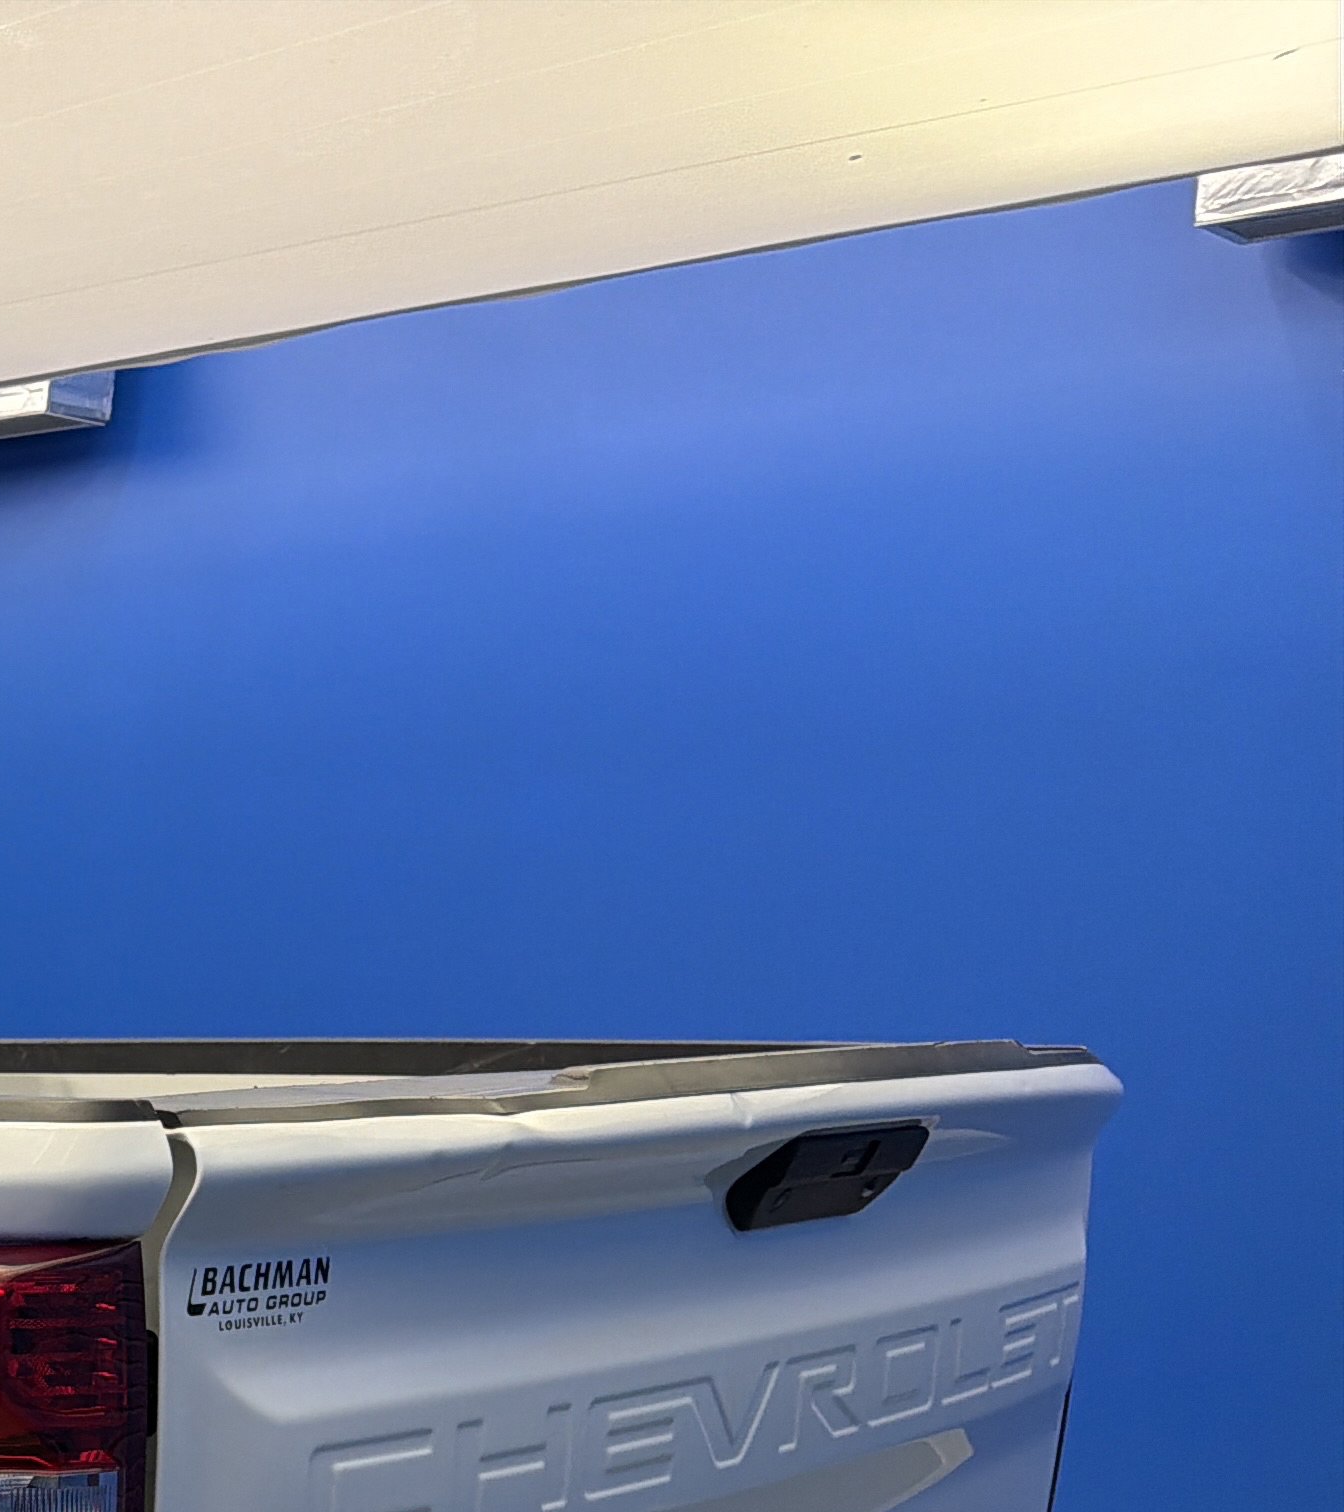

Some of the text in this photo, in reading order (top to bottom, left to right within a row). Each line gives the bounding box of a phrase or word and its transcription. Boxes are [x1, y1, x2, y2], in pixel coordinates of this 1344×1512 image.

[201, 1256, 331, 1297] BACHMAN
[207, 1290, 327, 1317] AUTO GROUP
[218, 1311, 304, 1332] LOUISVILLE, KY
